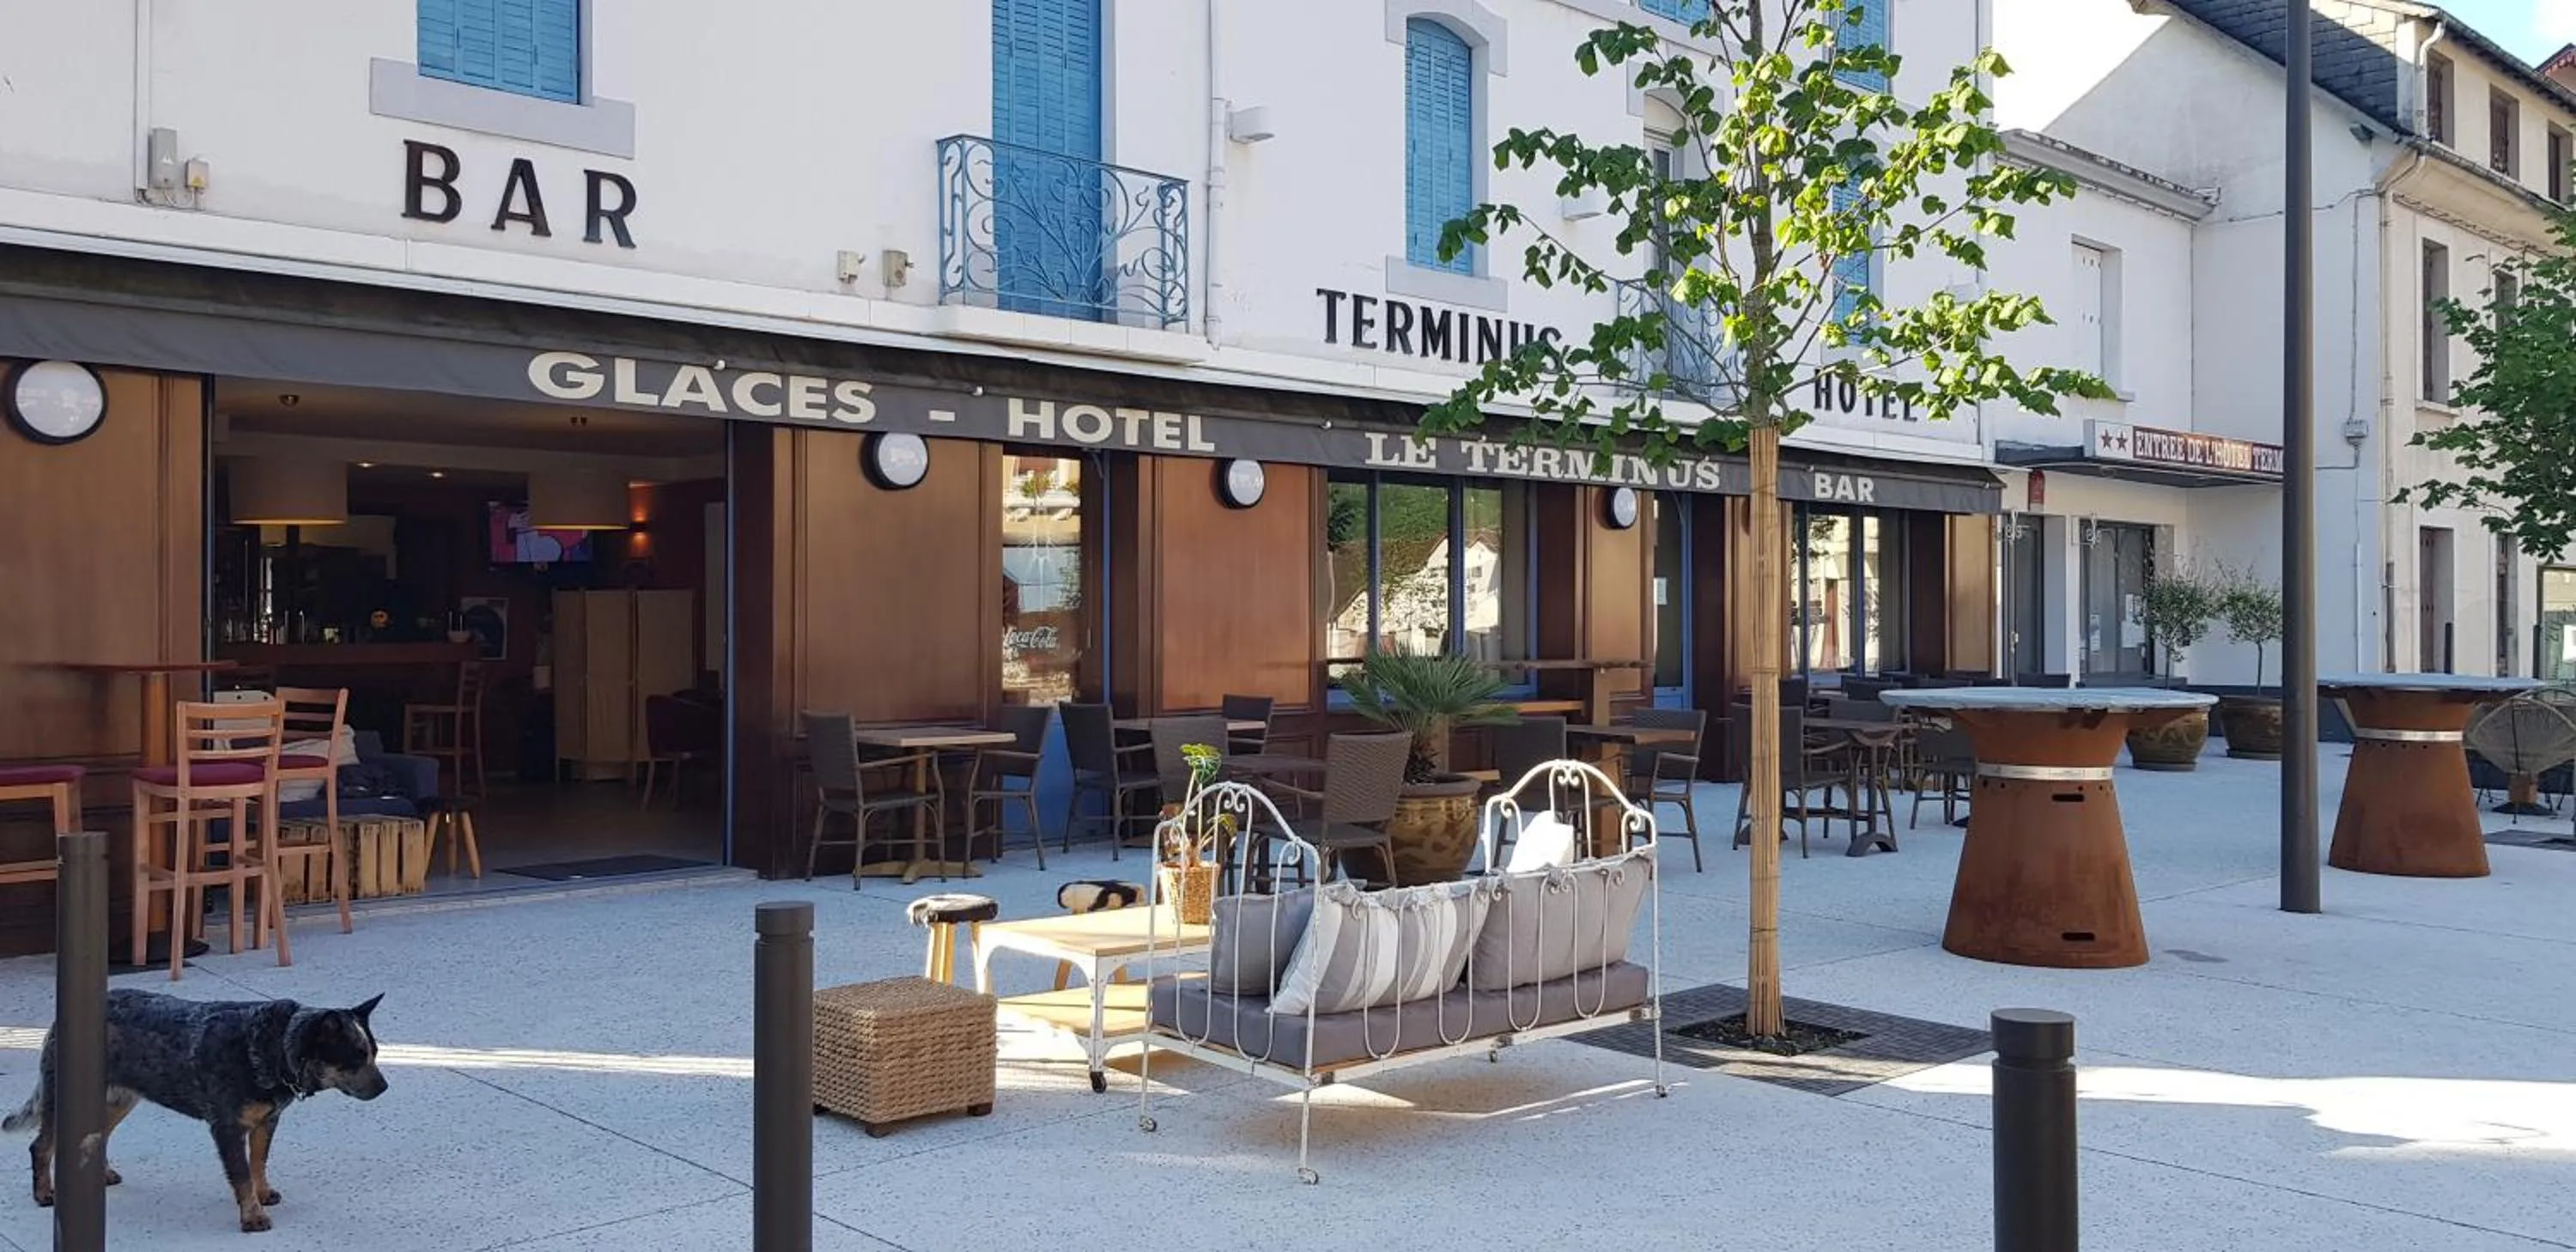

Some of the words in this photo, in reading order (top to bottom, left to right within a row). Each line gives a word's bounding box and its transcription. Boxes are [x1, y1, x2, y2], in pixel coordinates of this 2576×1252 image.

[400, 139, 637, 249] BAR
[527, 350, 877, 423] GLACES
[1007, 398, 1215, 453] HOTEL
[1364, 432, 1437, 469] LE
[1461, 440, 1720, 489] TERMINUS
[2187, 439, 2203, 463] DE
[1814, 472, 1875, 502] BAR
